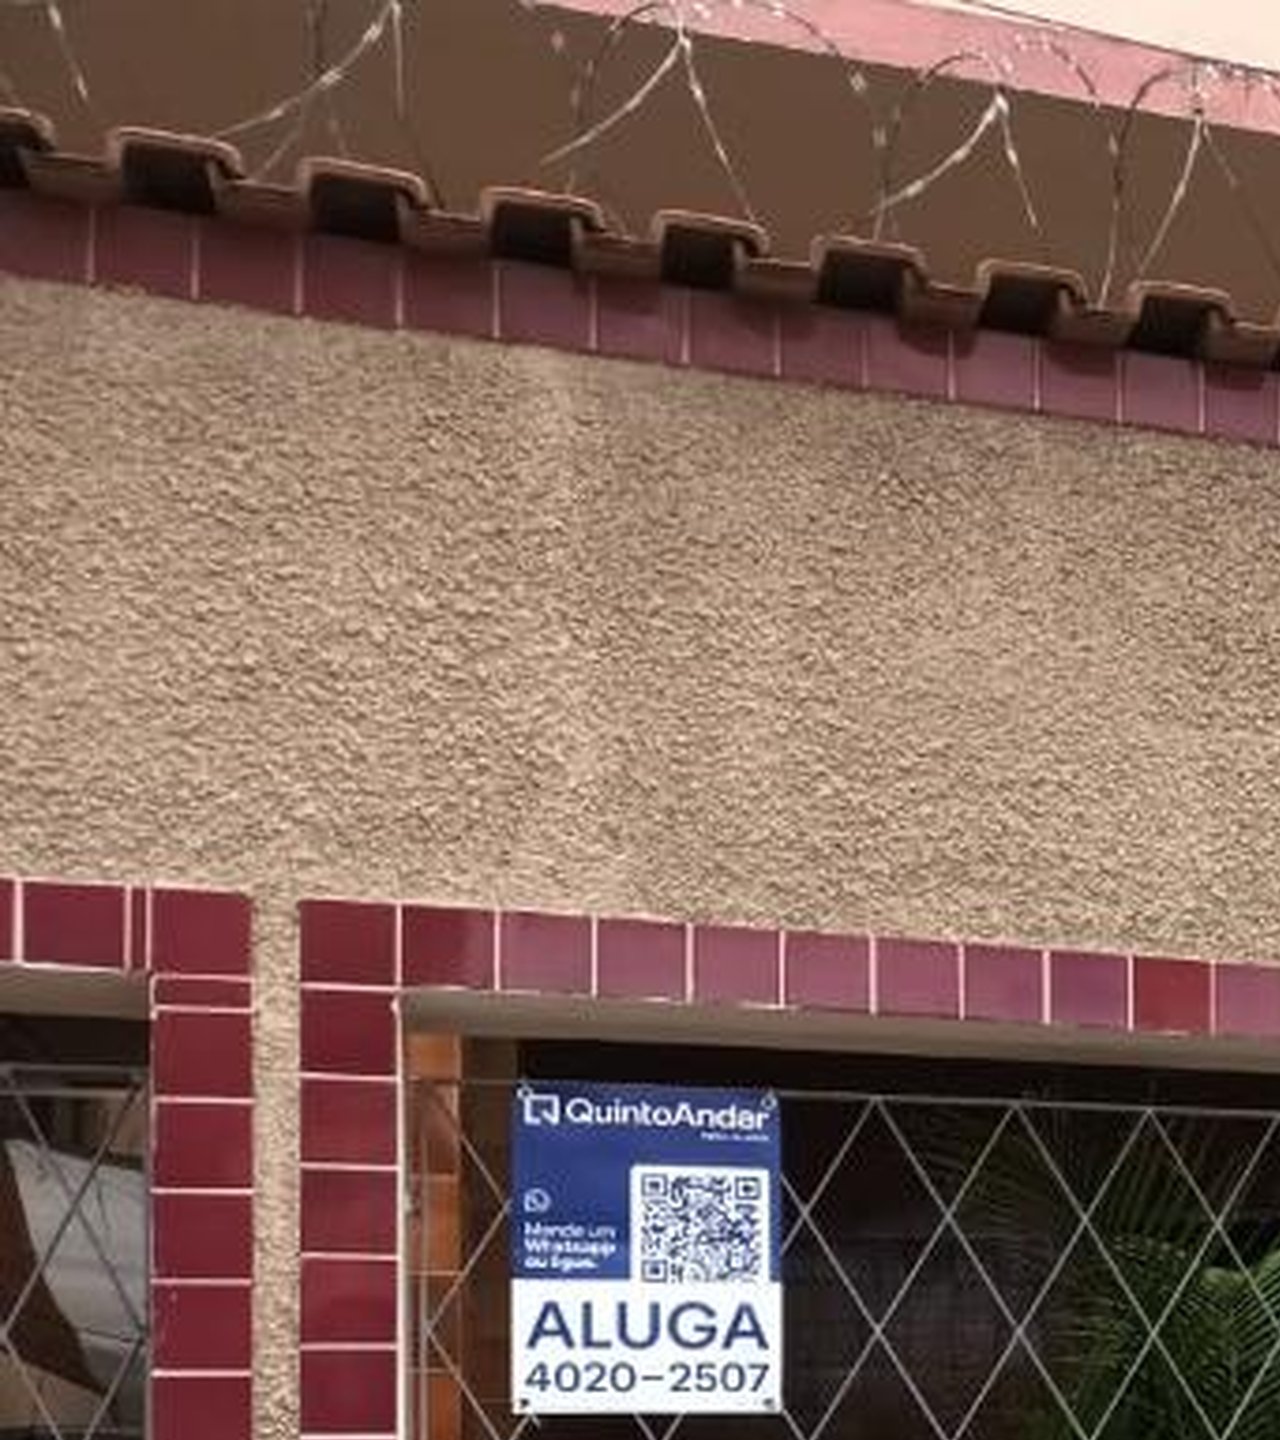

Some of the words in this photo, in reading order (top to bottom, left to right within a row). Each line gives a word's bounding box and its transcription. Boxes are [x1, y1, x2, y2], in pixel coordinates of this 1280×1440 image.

[565, 1097, 770, 1130] QuintoAndar
[526, 1300, 770, 1350] ALUGA
[524, 1361, 770, 1393] 4020-2507
